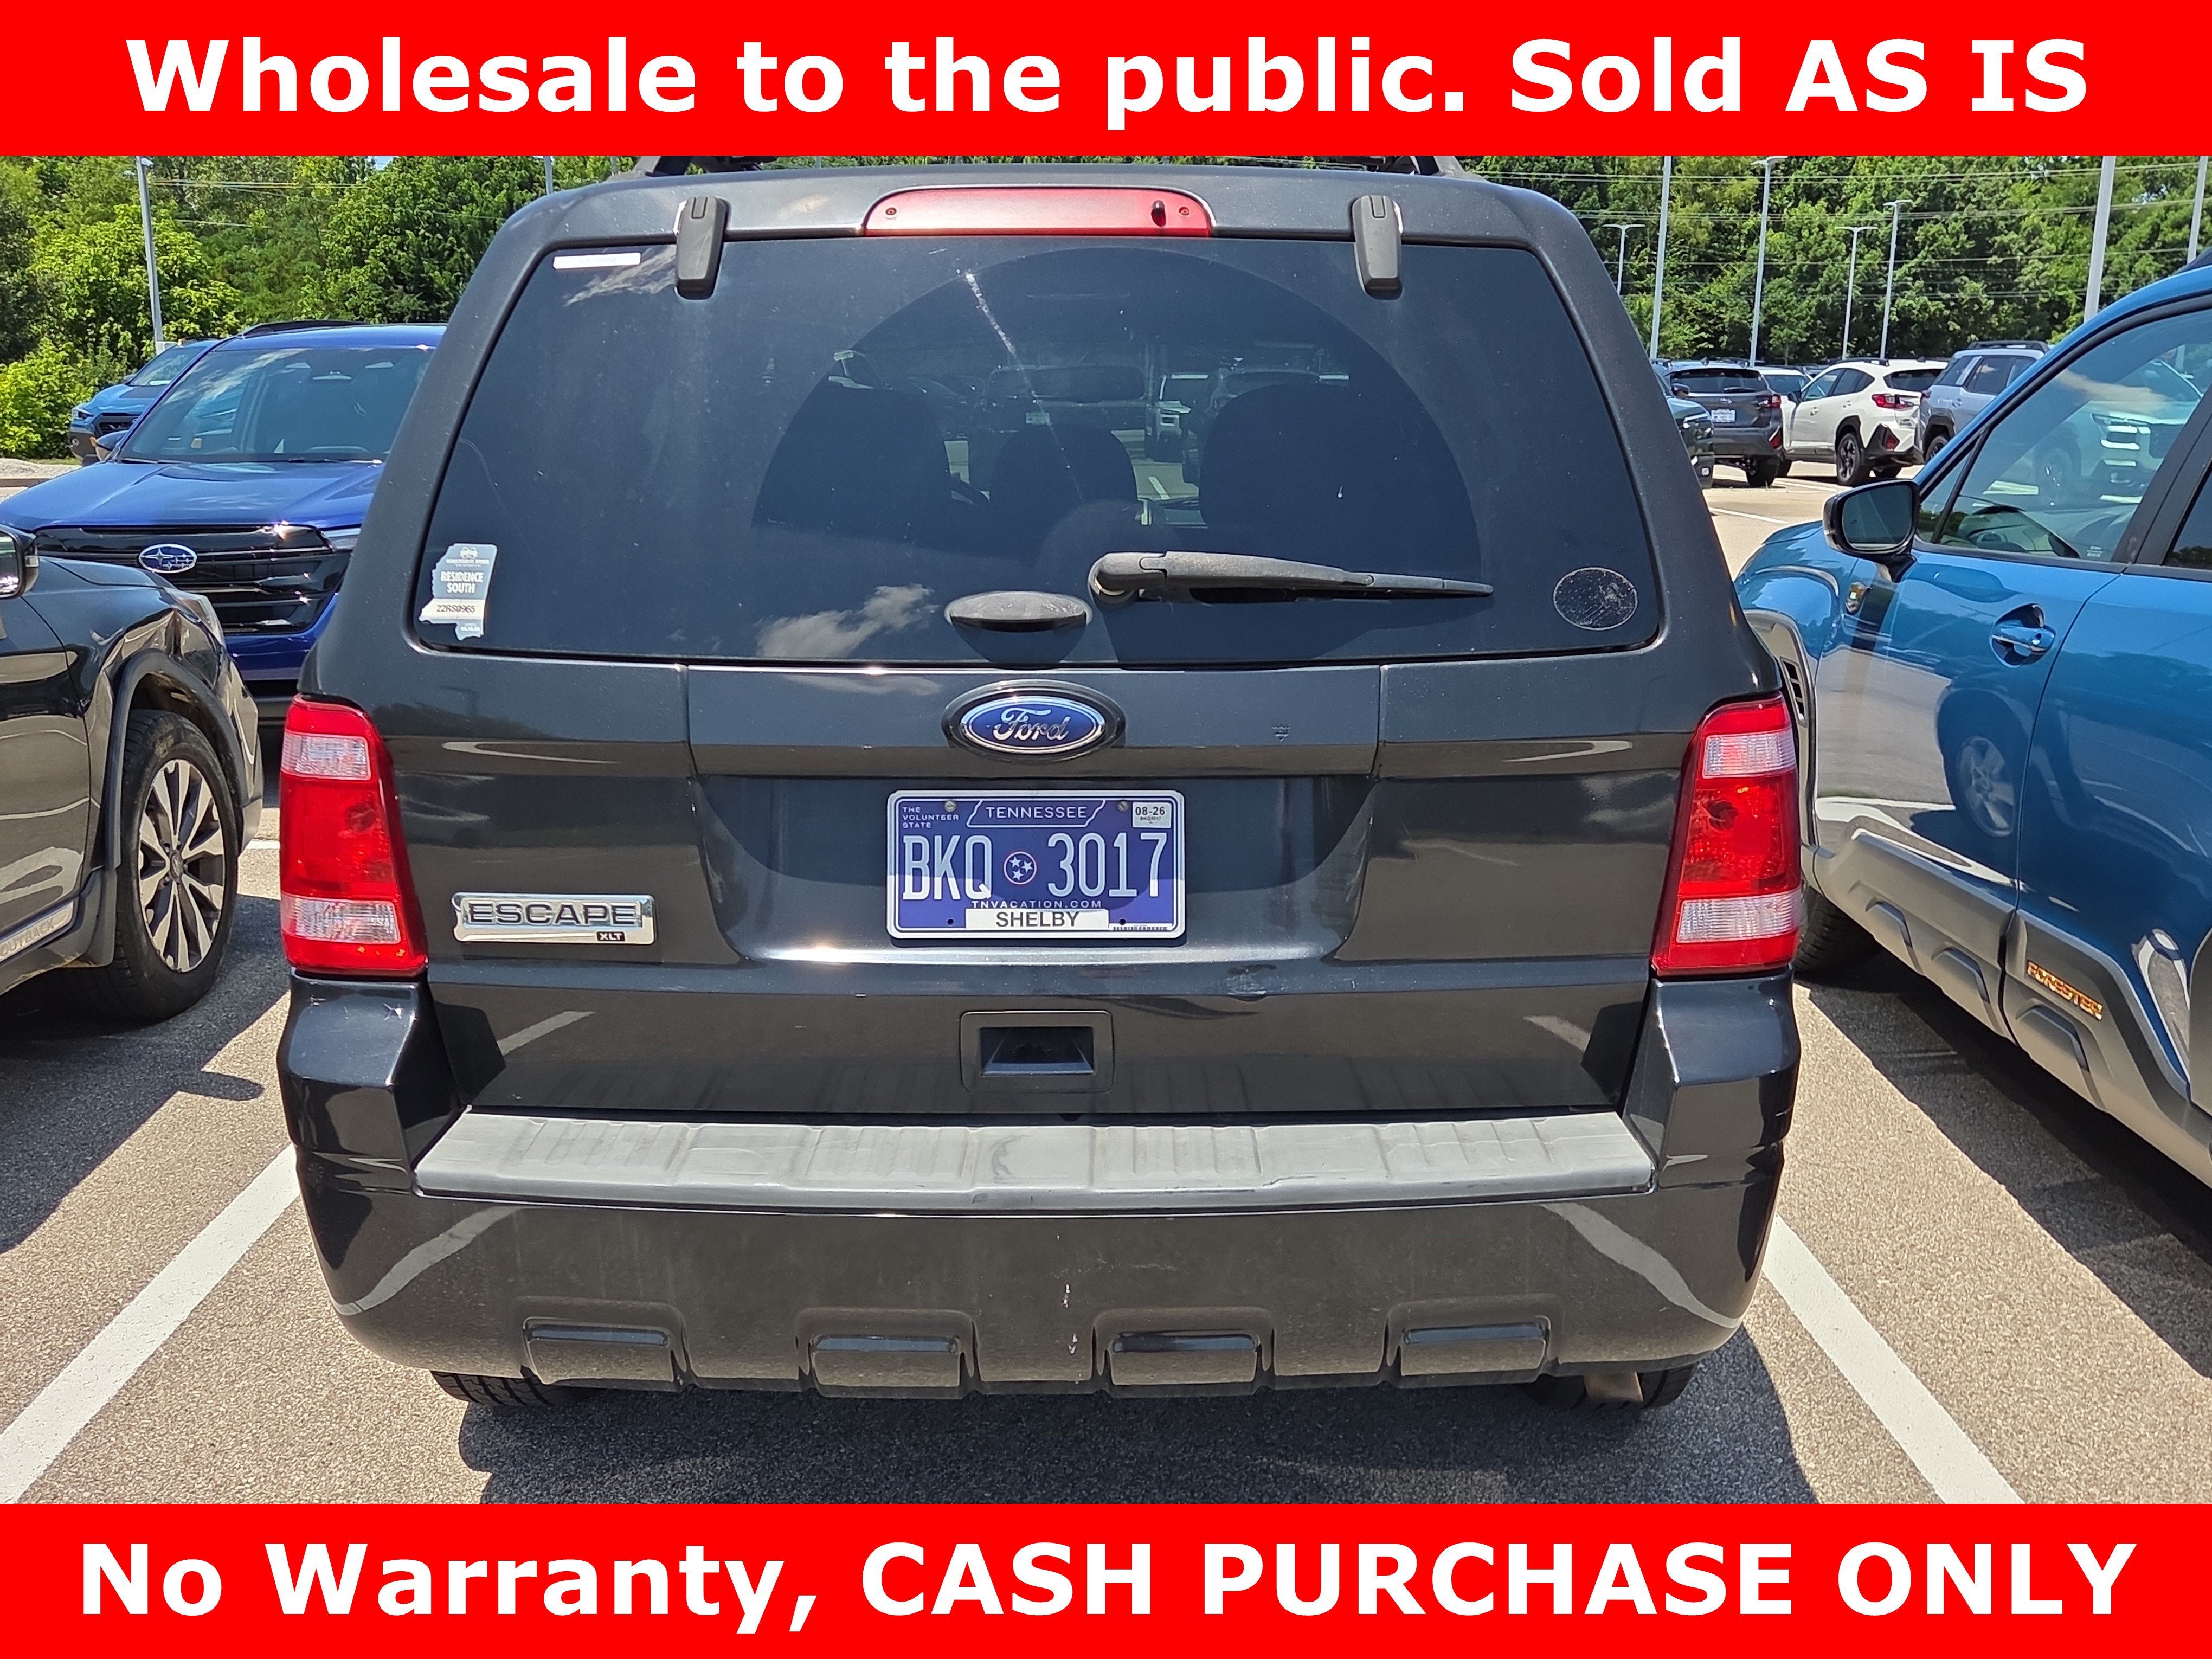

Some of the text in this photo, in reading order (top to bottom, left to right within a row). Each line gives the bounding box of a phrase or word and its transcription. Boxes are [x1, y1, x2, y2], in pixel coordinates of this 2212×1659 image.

[440, 571, 484, 583] RESIDENCE
[447, 583, 475, 594] SOUTH
[993, 706, 1071, 741] Ford
[985, 807, 1088, 819] TENNESSEE
[1135, 806, 1166, 816] 08-26
[902, 832, 1168, 900] BKQ 3017
[971, 900, 1102, 909] TNVACATION.COM
[468, 901, 639, 926] ESCAPE
[995, 911, 1081, 928] SHELBY
[0, 917, 55, 957] OUTBACK
[598, 933, 624, 941] XLT
[2027, 961, 2103, 1020] FORESTER
